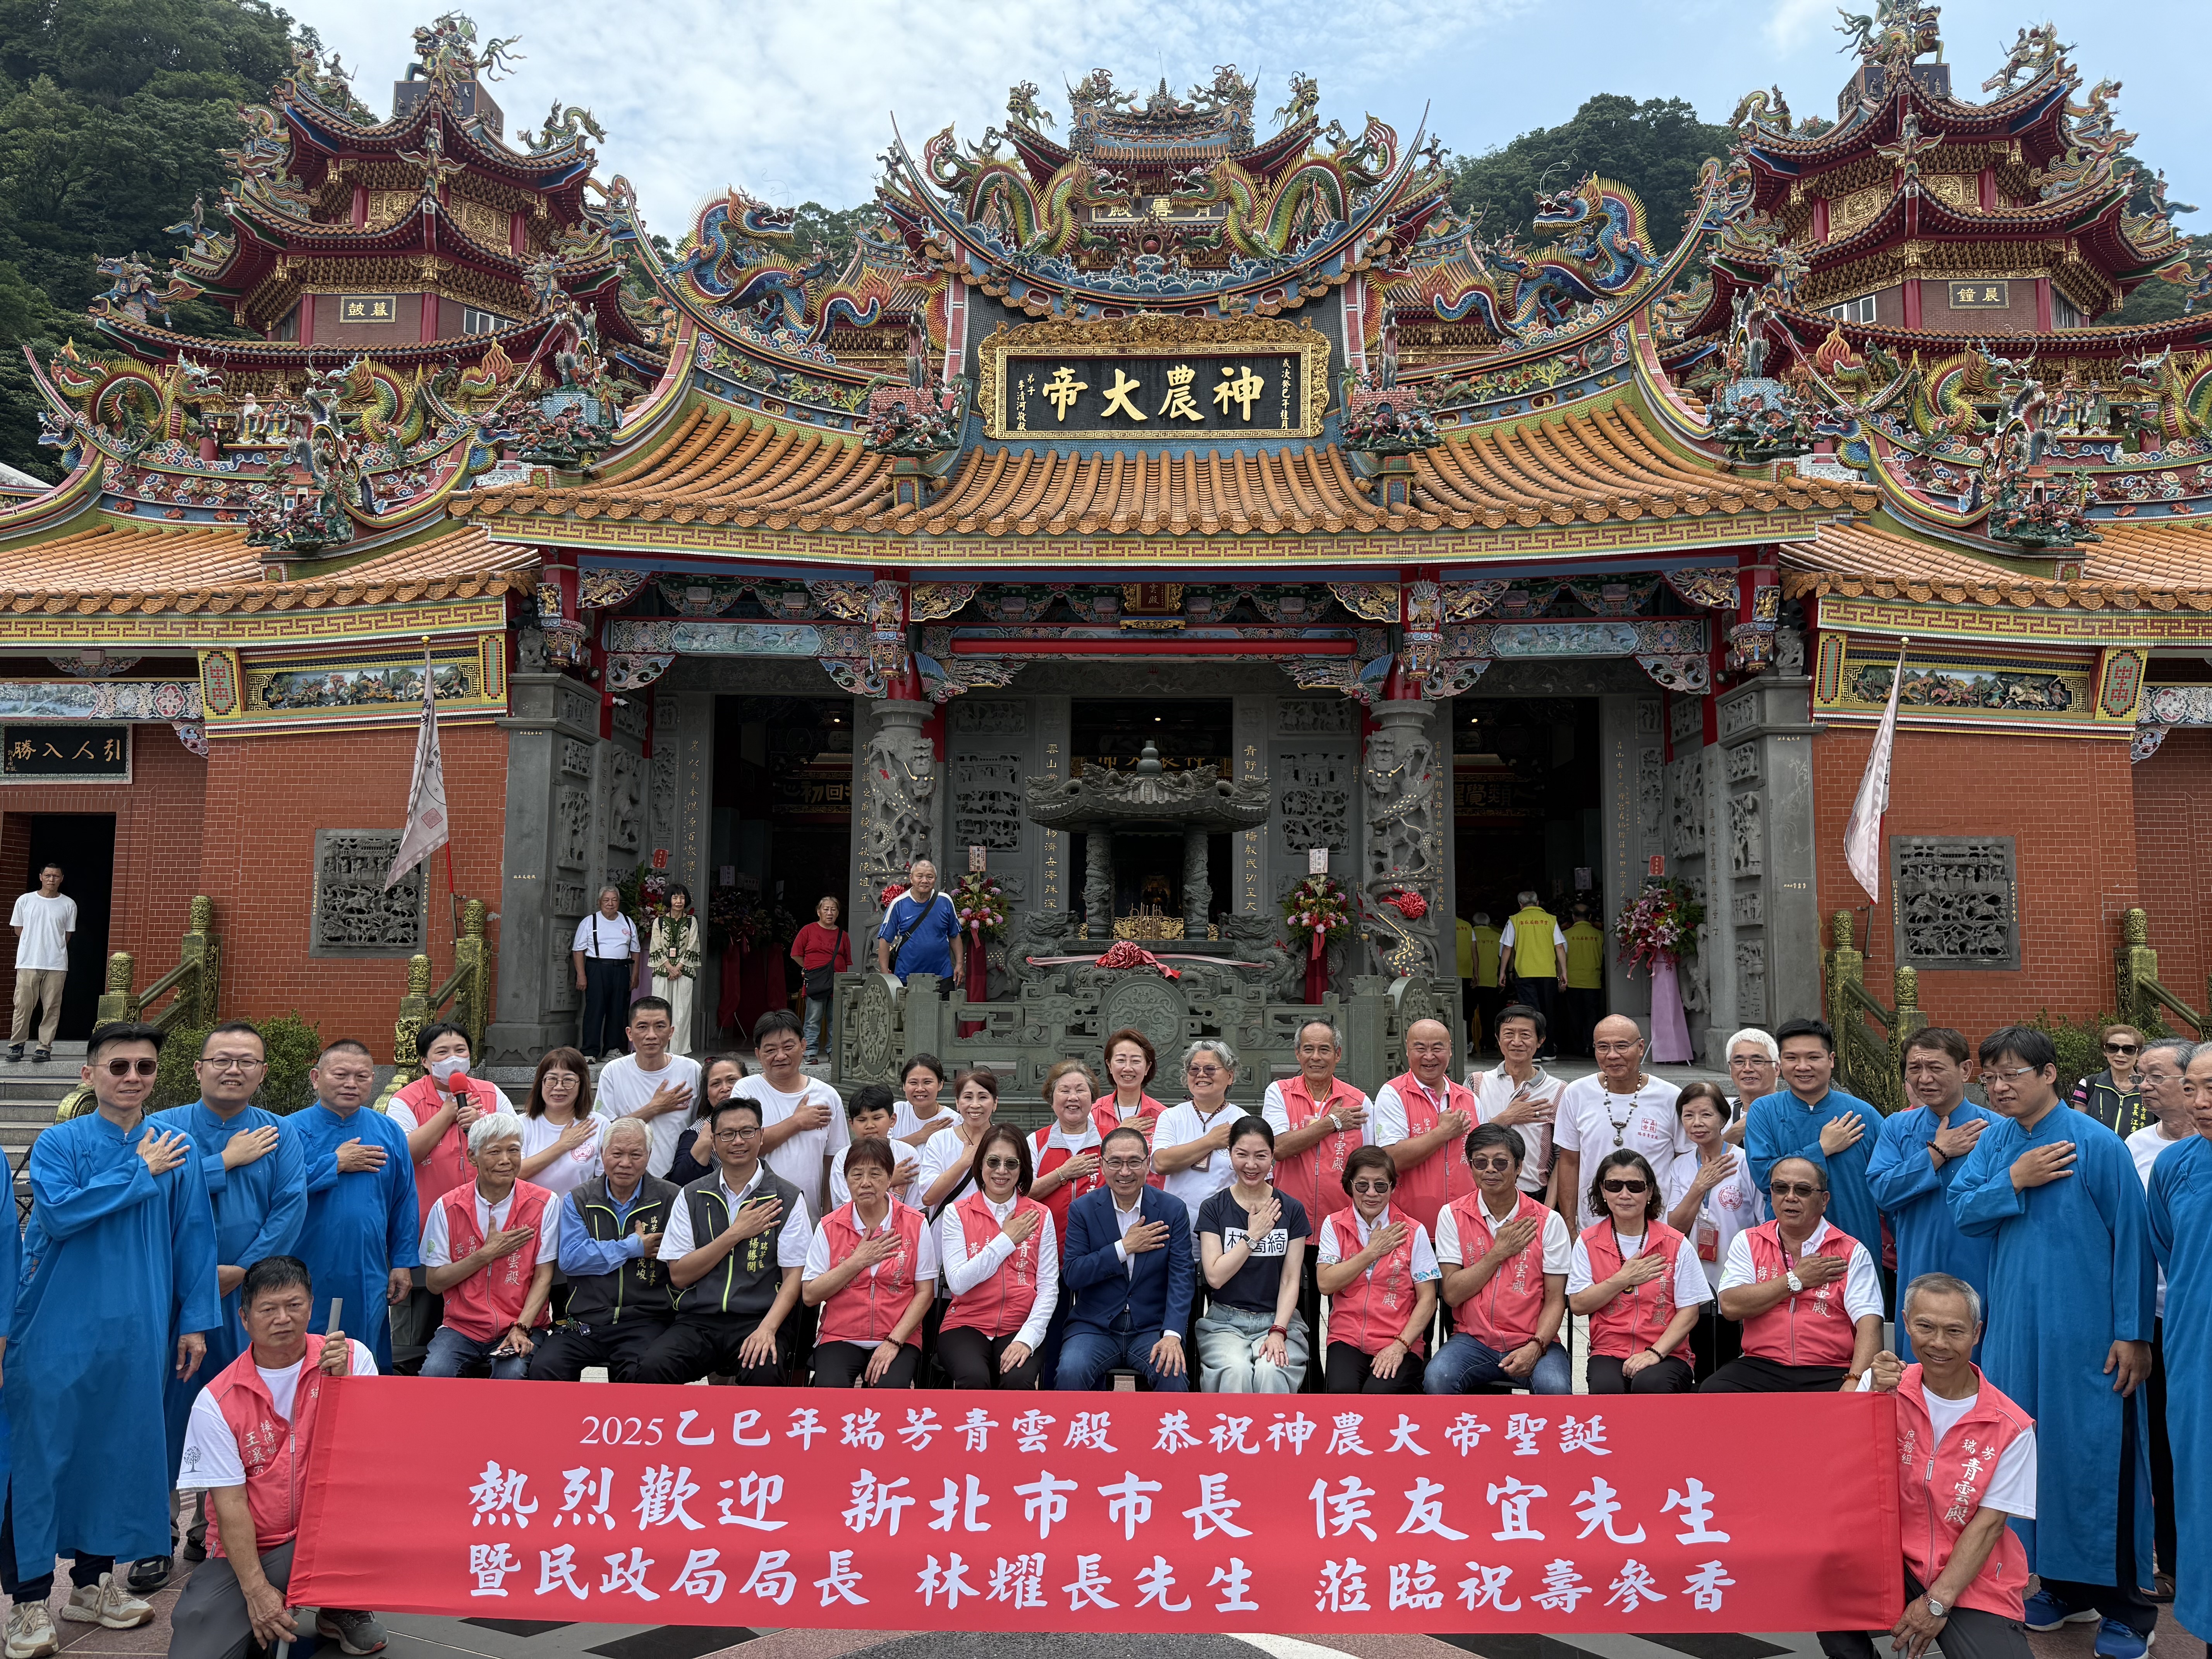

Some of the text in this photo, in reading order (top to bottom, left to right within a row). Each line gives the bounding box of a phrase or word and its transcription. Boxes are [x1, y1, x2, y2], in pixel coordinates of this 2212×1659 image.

[1027, 373, 1036, 396] 弟子
[1042, 364, 1265, 422] 神農大帝
[12, 739, 120, 762] 引人入勝
[505, 1248, 521, 1286] 雲殿
[1016, 1240, 1030, 1286] 青雲殿
[1382, 1259, 1403, 1310] 青雲殿
[1652, 1276, 1669, 1326] 青雲殿
[260, 1419, 279, 1455] 接待組
[580, 1408, 1612, 1458] 2025乙巳年瑞芳青雲殿 恭祝神農大帝聖誕
[1902, 1429, 1915, 1465] 庶務組
[1961, 1439, 1996, 1460] 瑞芳
[469, 1462, 1731, 1546] 熱烈歡迎 新北市市長 侯友宜先生
[1944, 1457, 1984, 1526] 青雲殿
[469, 1543, 1736, 1614] 暨民政局局長 林耀長先生 蒞臨祝壽參香
